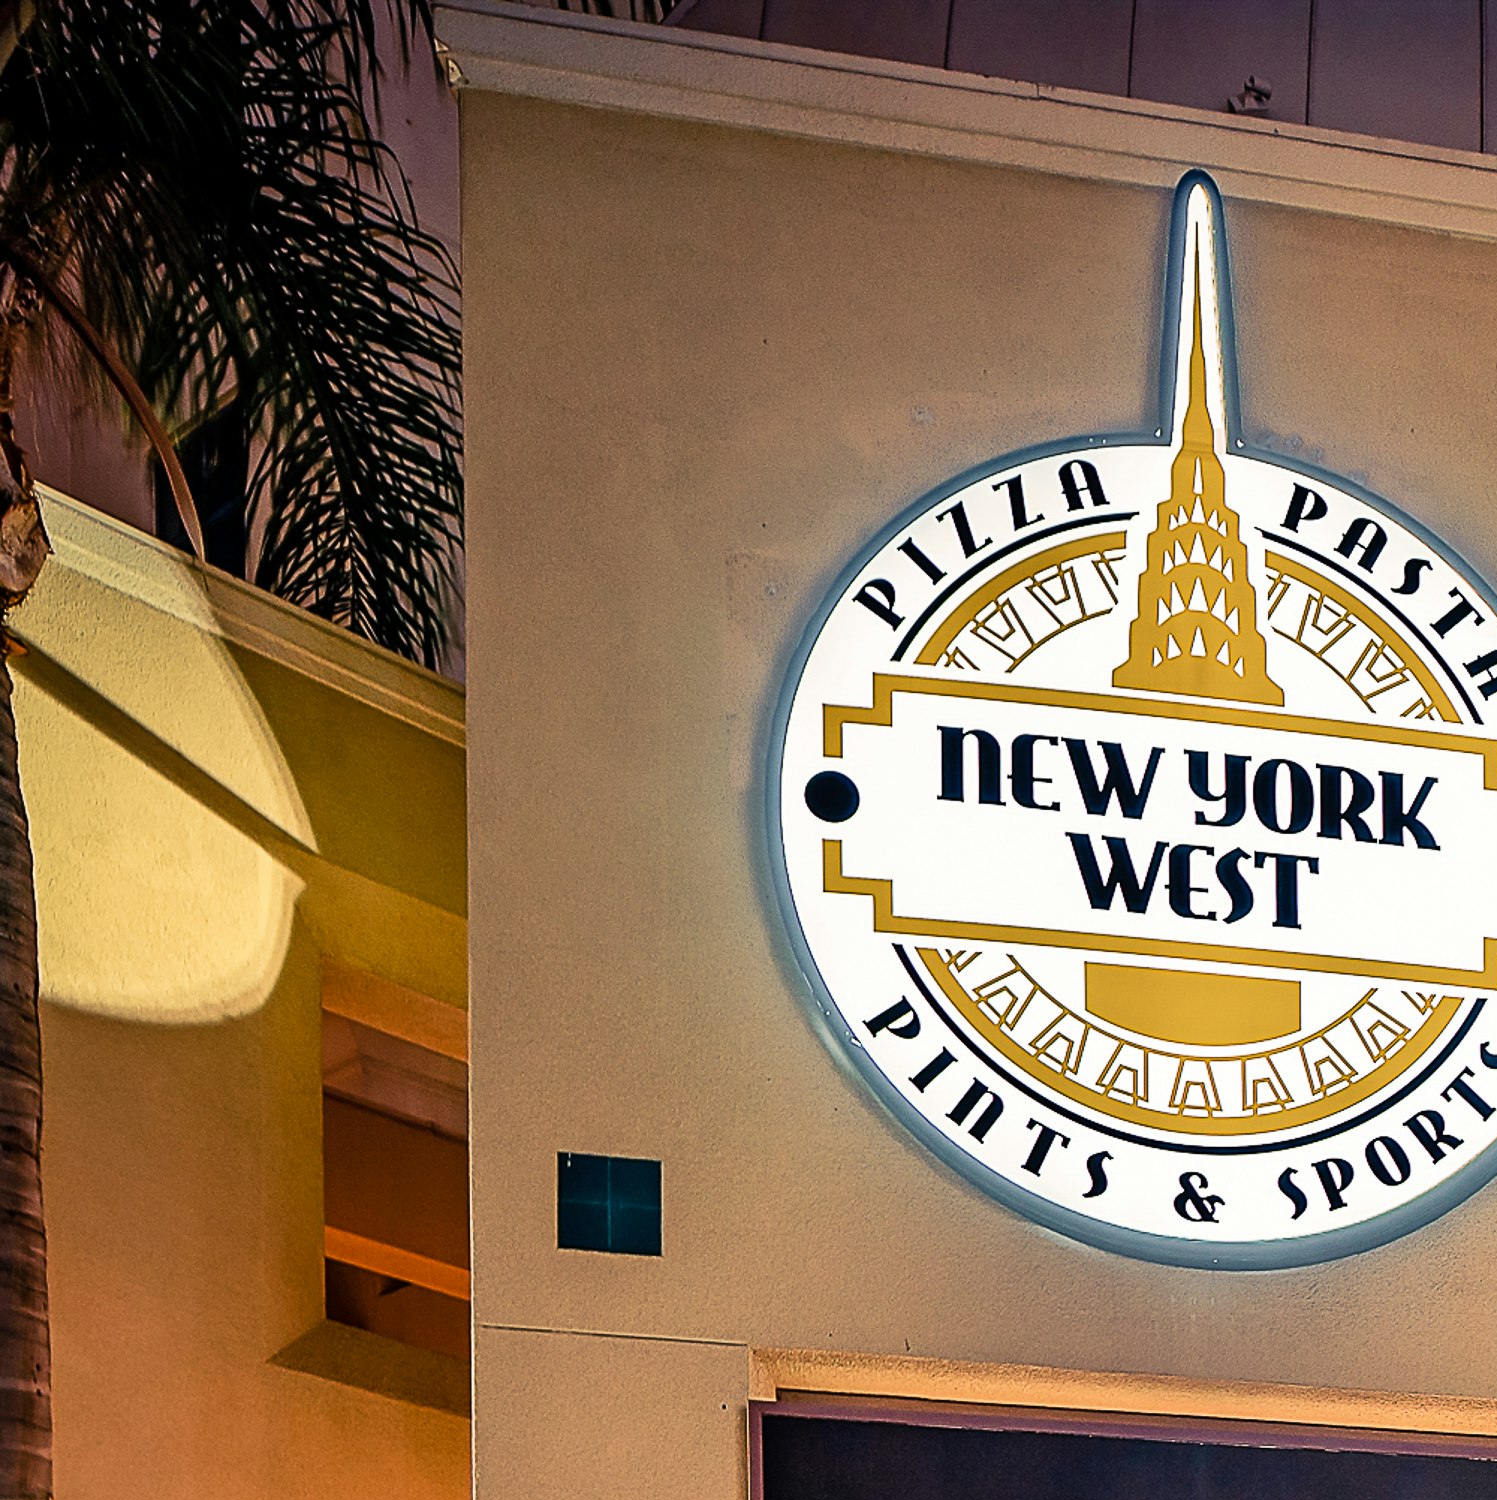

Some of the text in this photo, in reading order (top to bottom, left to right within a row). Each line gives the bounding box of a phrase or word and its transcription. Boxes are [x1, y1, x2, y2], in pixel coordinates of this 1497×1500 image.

[852, 459, 1111, 632] PIZZA
[936, 725, 1441, 852] NEW YORK
[1064, 831, 1320, 930] WEST
[861, 995, 1114, 1199] PINTS
[1173, 1171, 1226, 1224] &
